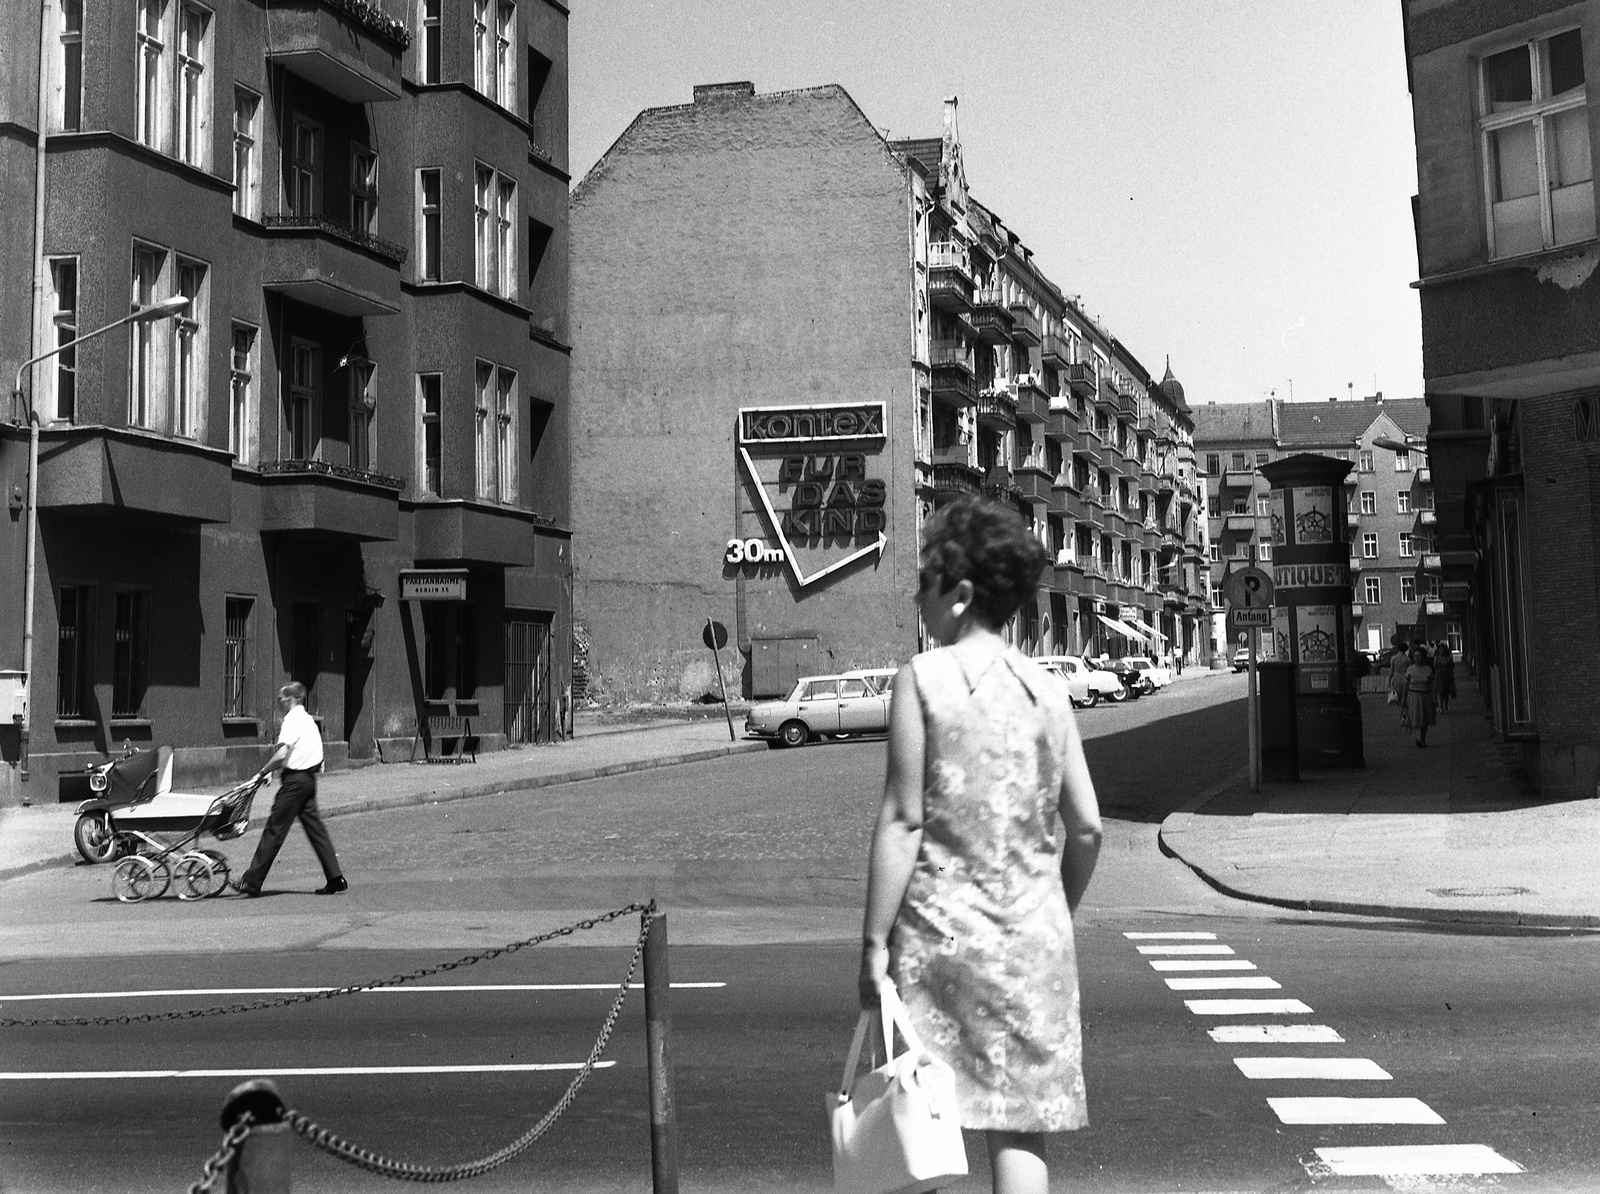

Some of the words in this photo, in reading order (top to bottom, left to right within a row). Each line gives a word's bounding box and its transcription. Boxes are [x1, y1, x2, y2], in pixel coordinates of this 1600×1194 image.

[746, 410, 880, 439] kontex
[794, 479, 886, 507] DAS
[784, 508, 886, 535] KIND
[726, 538, 784, 563] 30m
[405, 577, 459, 586] PAKETANNAHME
[1236, 610, 1267, 624] Anfang
